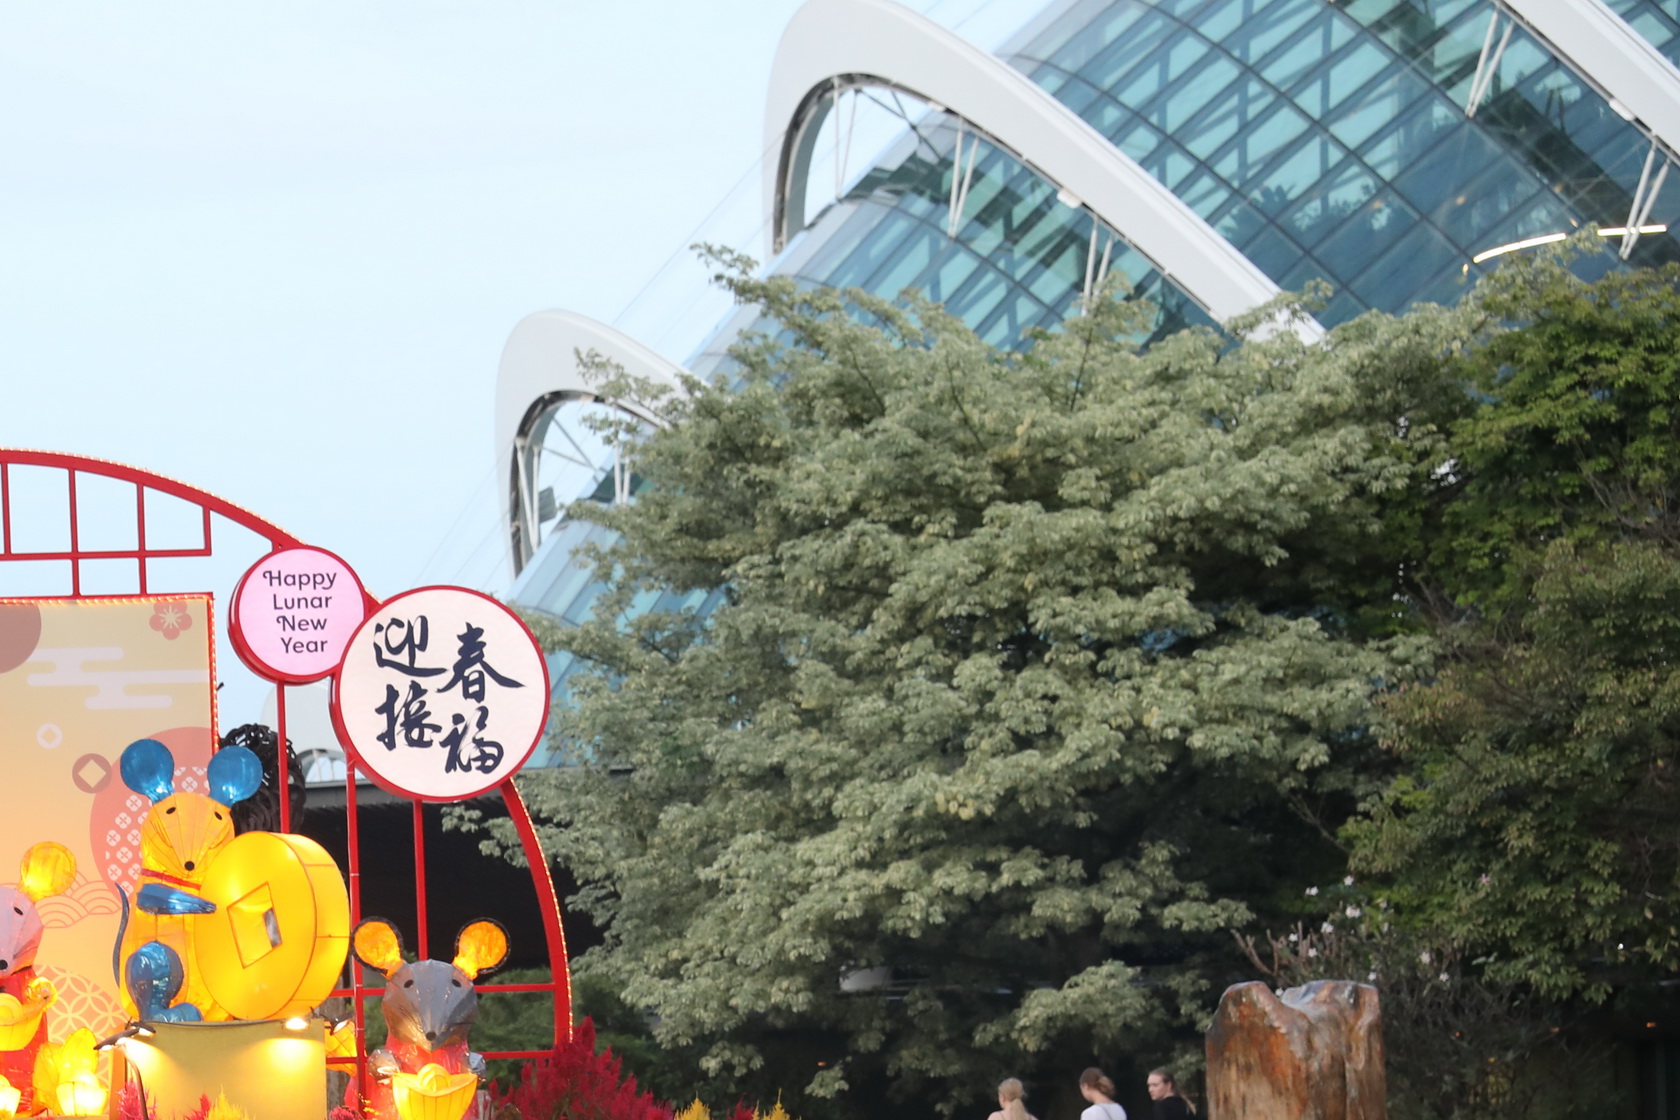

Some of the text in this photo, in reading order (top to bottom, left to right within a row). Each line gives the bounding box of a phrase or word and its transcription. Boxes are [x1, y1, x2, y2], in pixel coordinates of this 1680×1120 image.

[263, 570, 337, 590] Happy
[272, 594, 332, 610] Lunar
[276, 616, 328, 632] New
[280, 638, 328, 653] Year
